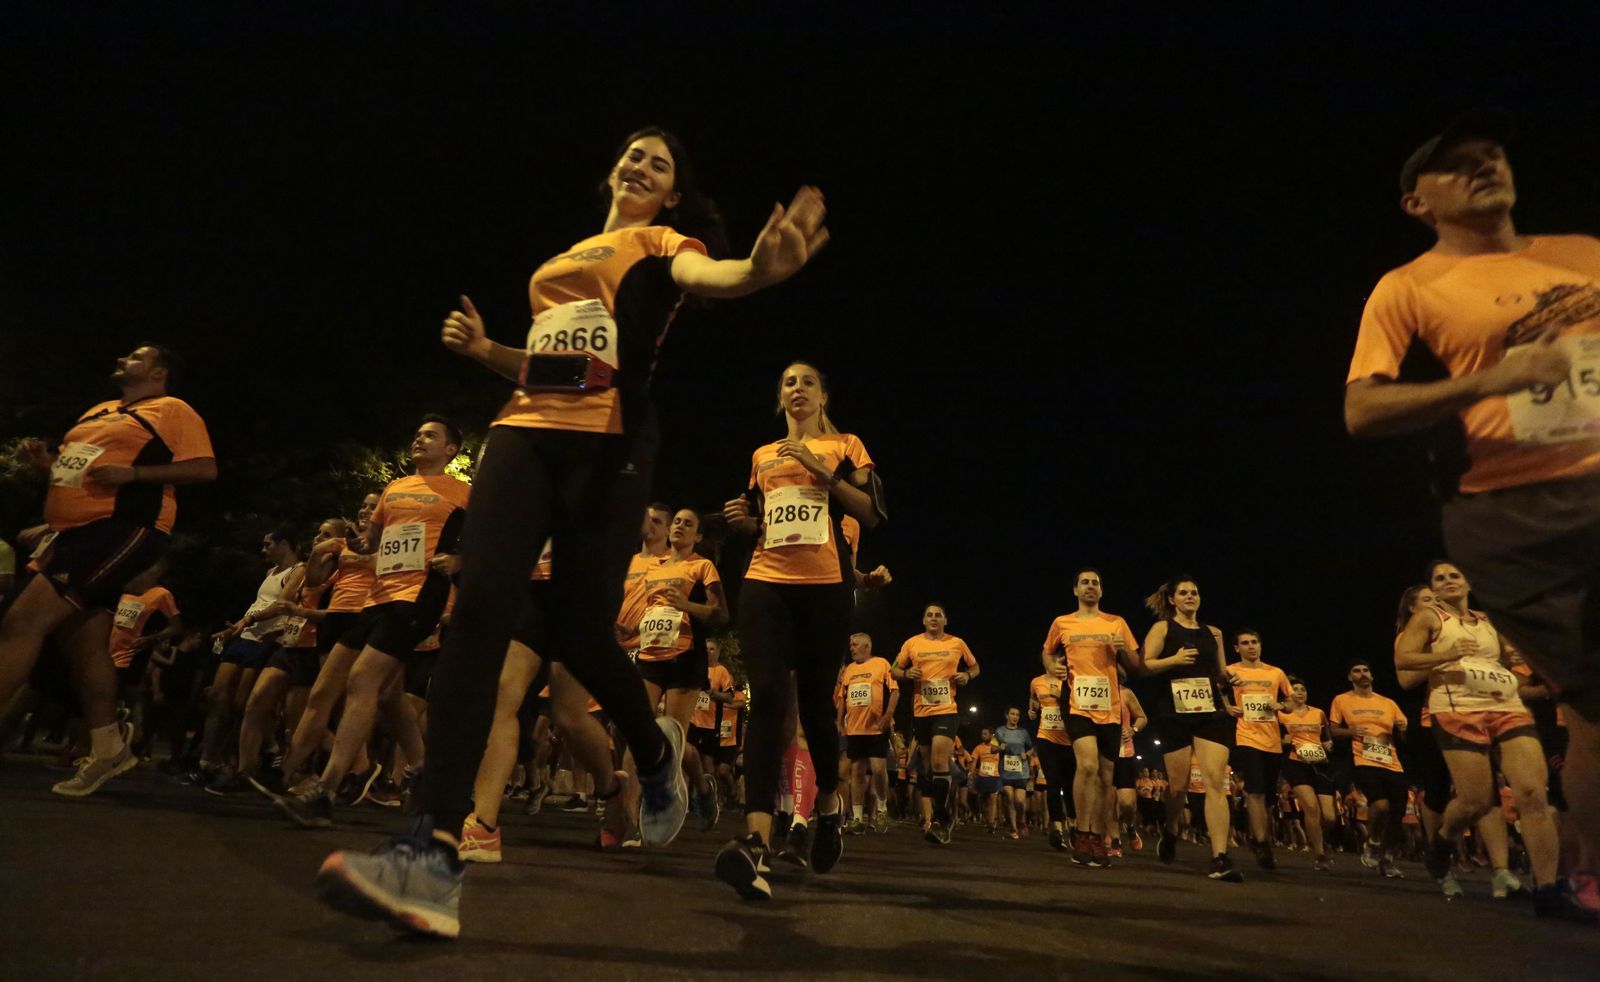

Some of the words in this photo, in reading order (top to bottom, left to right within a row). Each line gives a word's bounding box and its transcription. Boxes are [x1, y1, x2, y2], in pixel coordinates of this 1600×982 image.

[767, 504, 823, 526] 12867
[379, 537, 421, 557] 15917
[644, 619, 673, 632] 7063
[1468, 668, 1512, 685] 17457
[850, 690, 868, 699] 8266
[923, 686, 949, 697] 13923
[1076, 686, 1109, 699] 17521
[1176, 688, 1212, 701] 17461
[1298, 749, 1325, 758] 13055
